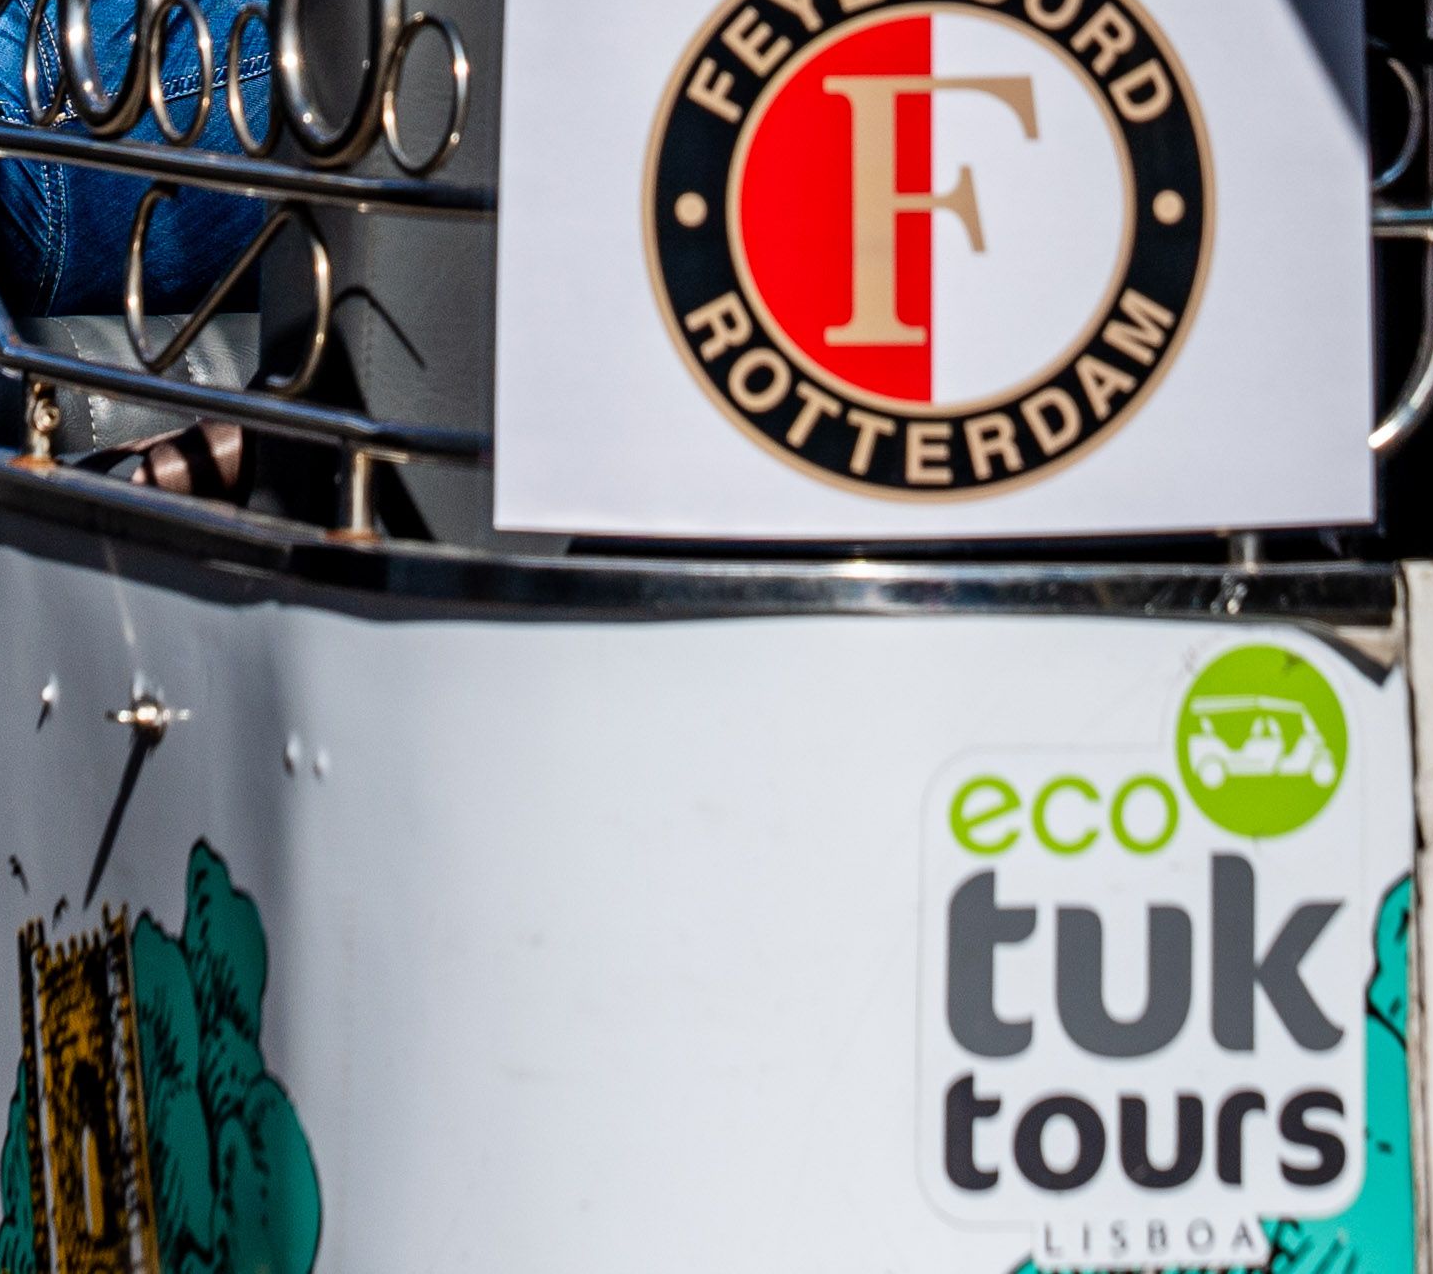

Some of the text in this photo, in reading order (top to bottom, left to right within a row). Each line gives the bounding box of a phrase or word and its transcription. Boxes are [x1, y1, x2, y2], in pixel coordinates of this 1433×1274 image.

[821, 73, 1040, 348] F
[684, 286, 1175, 486] ROTTERDAM
[947, 772, 1181, 857] eco
[944, 851, 1346, 1059] tuk
[943, 1068, 1348, 1193] tours
[1042, 1217, 1257, 1257] LISBOA
